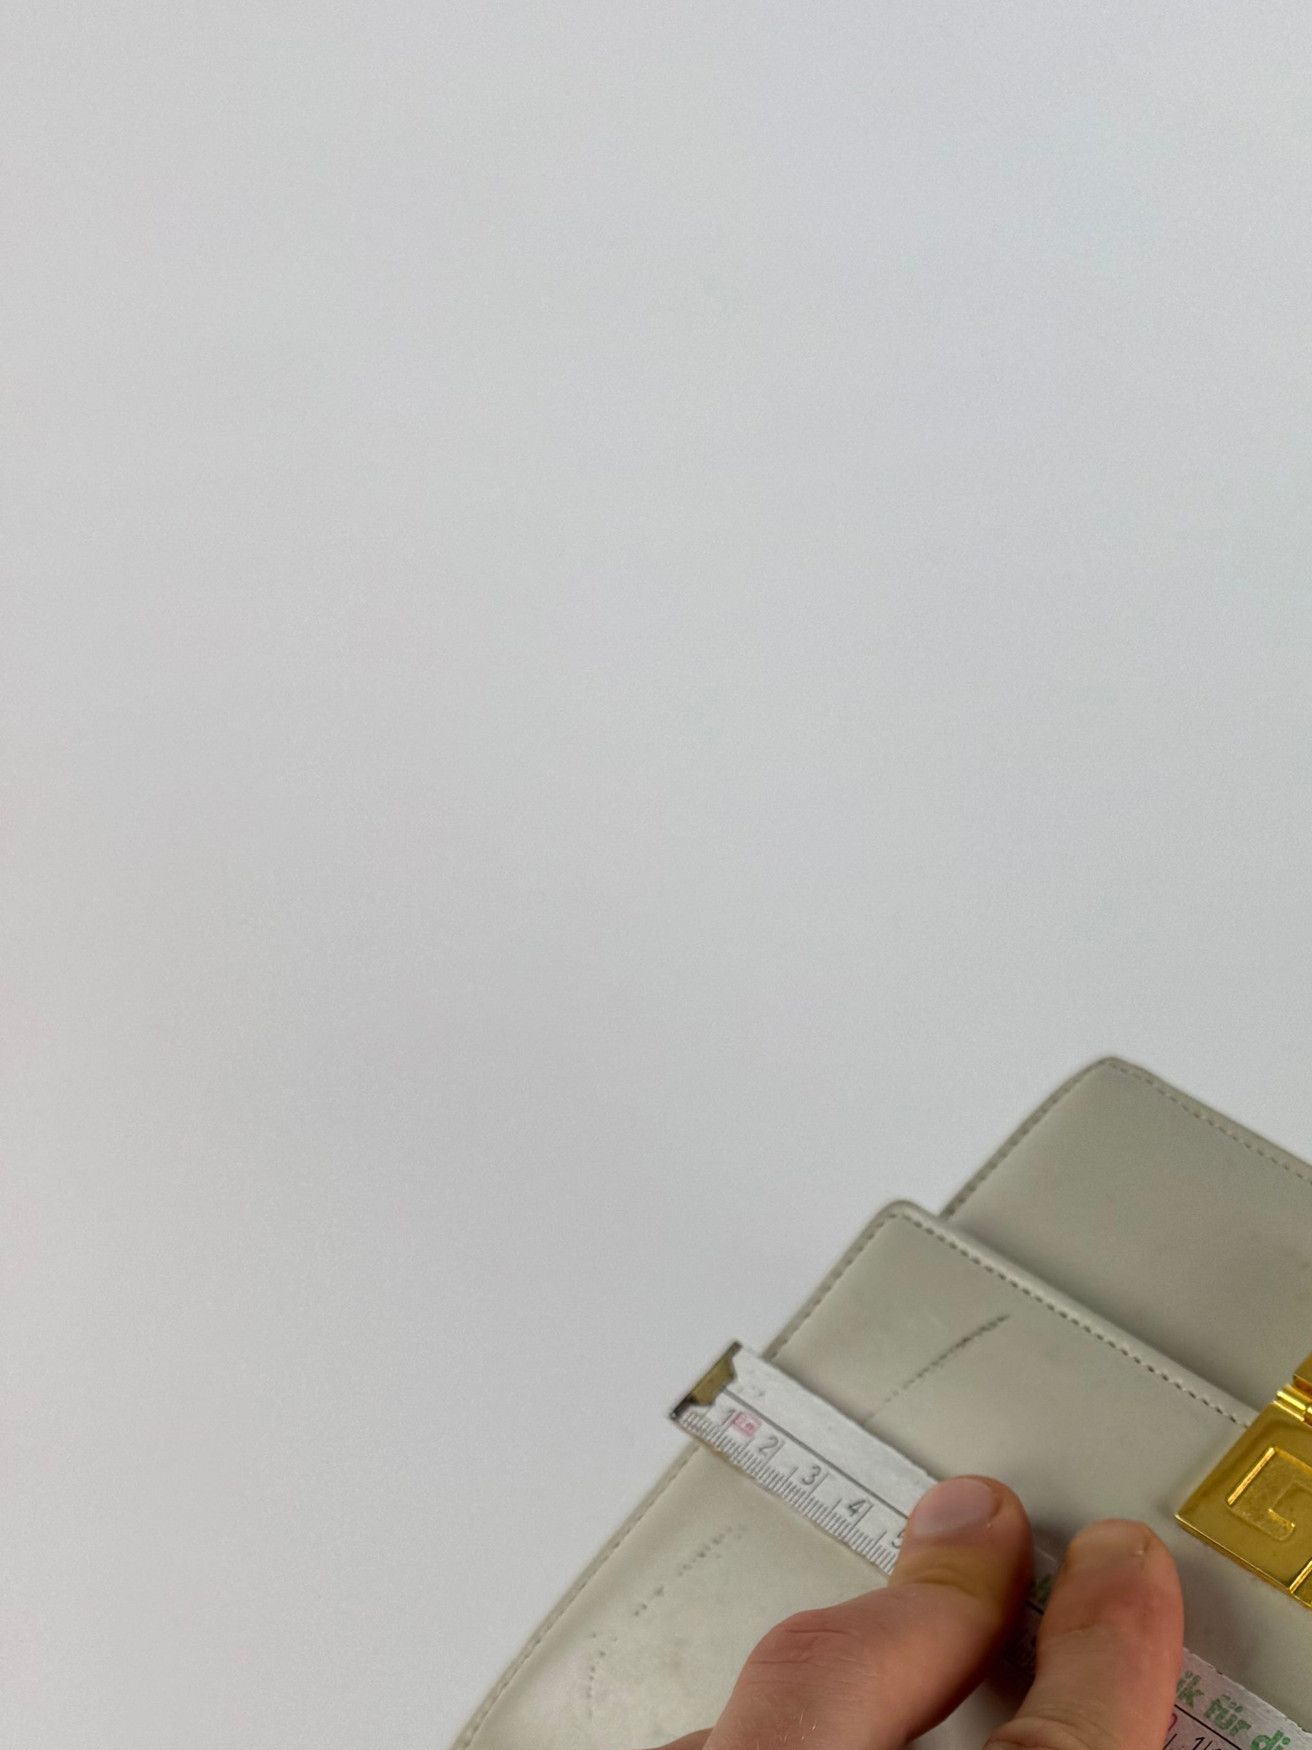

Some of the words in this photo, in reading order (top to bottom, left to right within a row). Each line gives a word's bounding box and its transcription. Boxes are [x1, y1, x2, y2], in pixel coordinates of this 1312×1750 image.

[757, 1434, 780, 1457] 2
[800, 1464, 823, 1487] 3
[846, 1498, 868, 1519] 4
[1203, 1693, 1252, 1738] für
